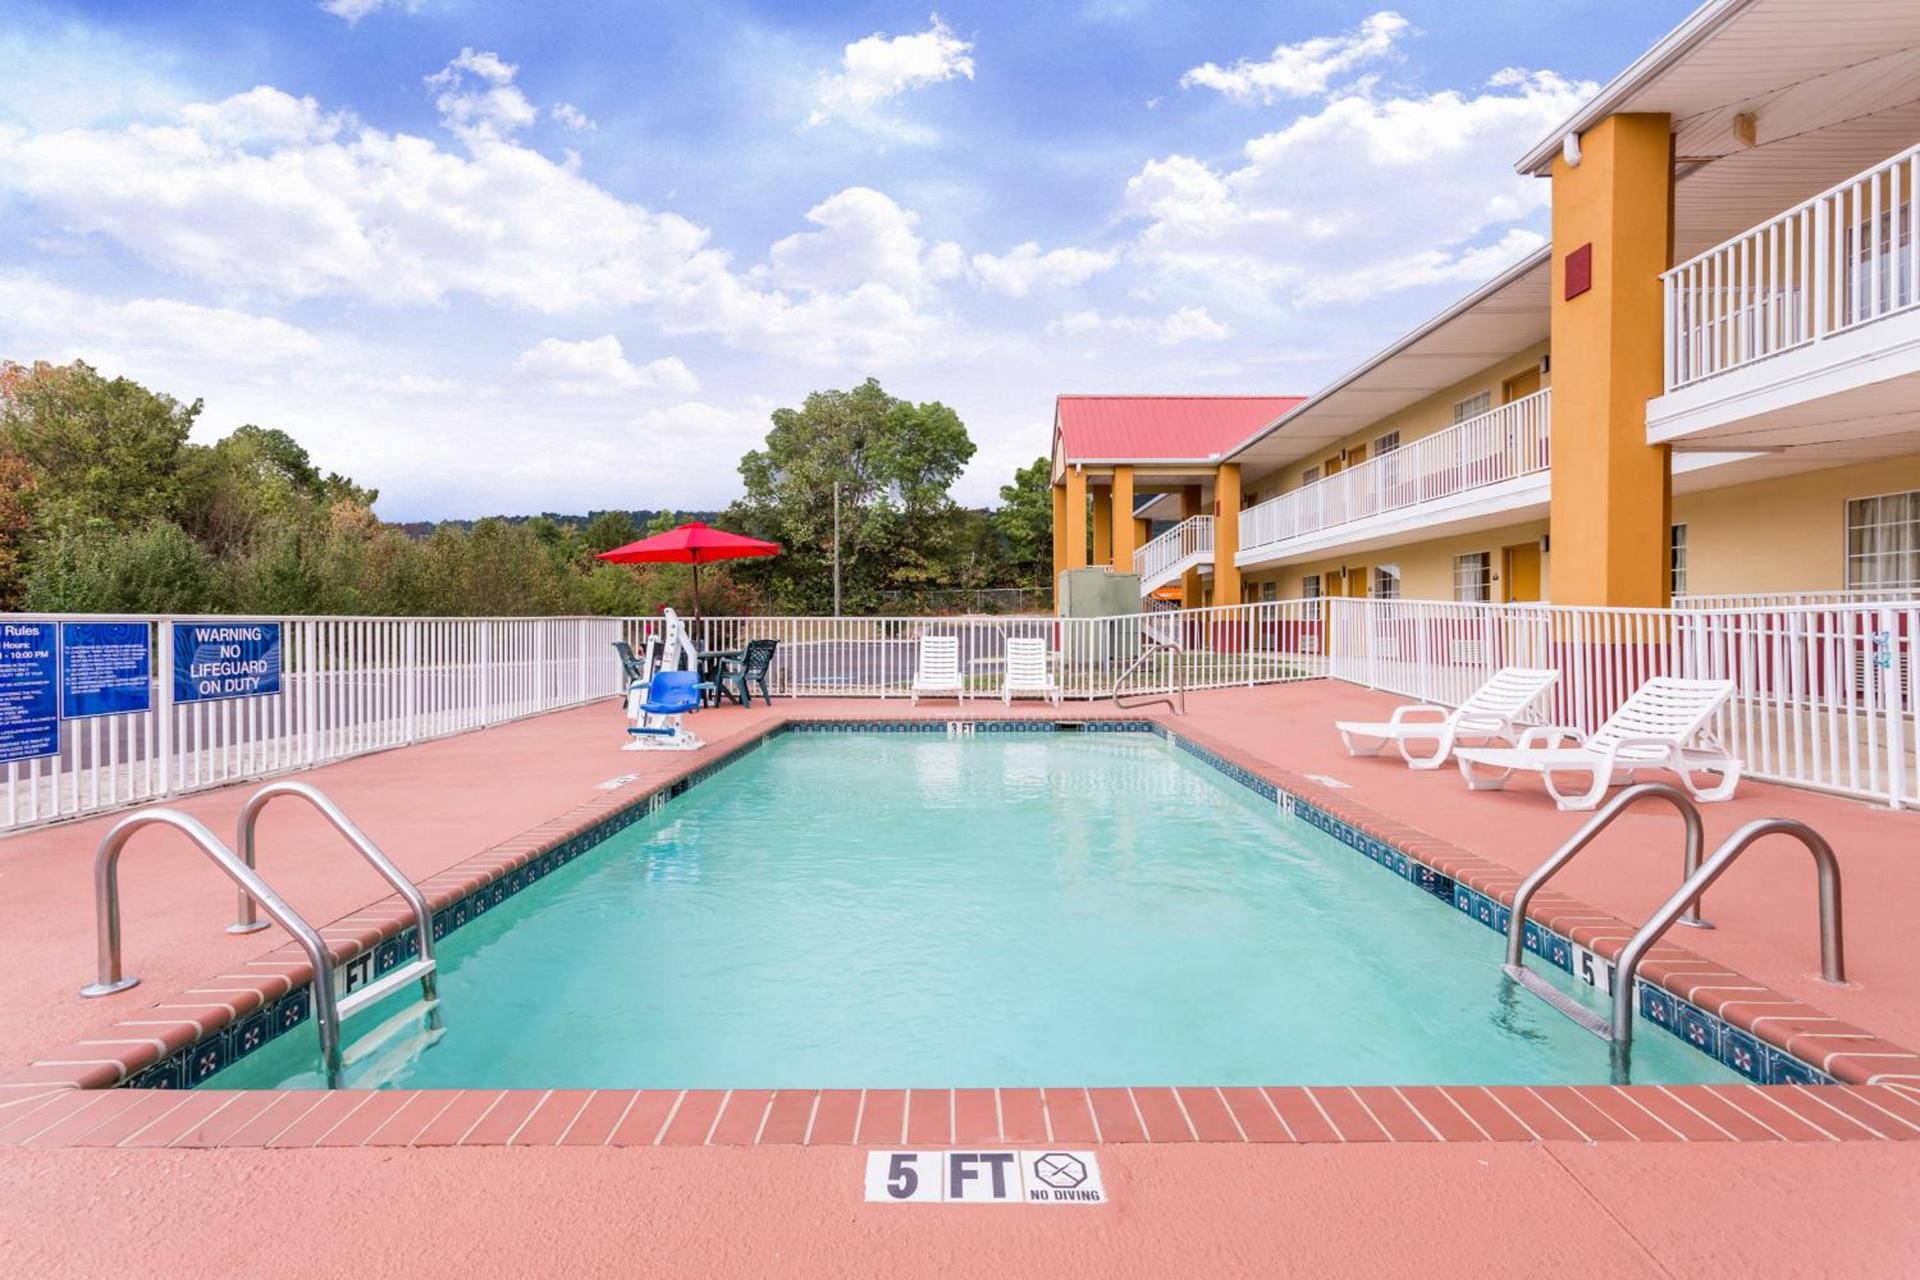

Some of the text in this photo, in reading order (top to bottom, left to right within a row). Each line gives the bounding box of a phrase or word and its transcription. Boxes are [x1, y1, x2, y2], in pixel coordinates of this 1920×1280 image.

[5, 625, 40, 636] Rules
[195, 628, 262, 642] WARNING
[3, 641, 31, 649] Hours:
[220, 644, 241, 659] NO
[11, 651, 33, 659] 10:00
[190, 660, 267, 678] LIFEGUARD
[200, 677, 260, 695] ON DUTY
[952, 722, 973, 733] 3 FT
[346, 952, 372, 994] FT
[1582, 951, 1595, 987] 5
[886, 1153, 1014, 1199] 5 FT
[1030, 1190, 1100, 1201] NO DIVING
